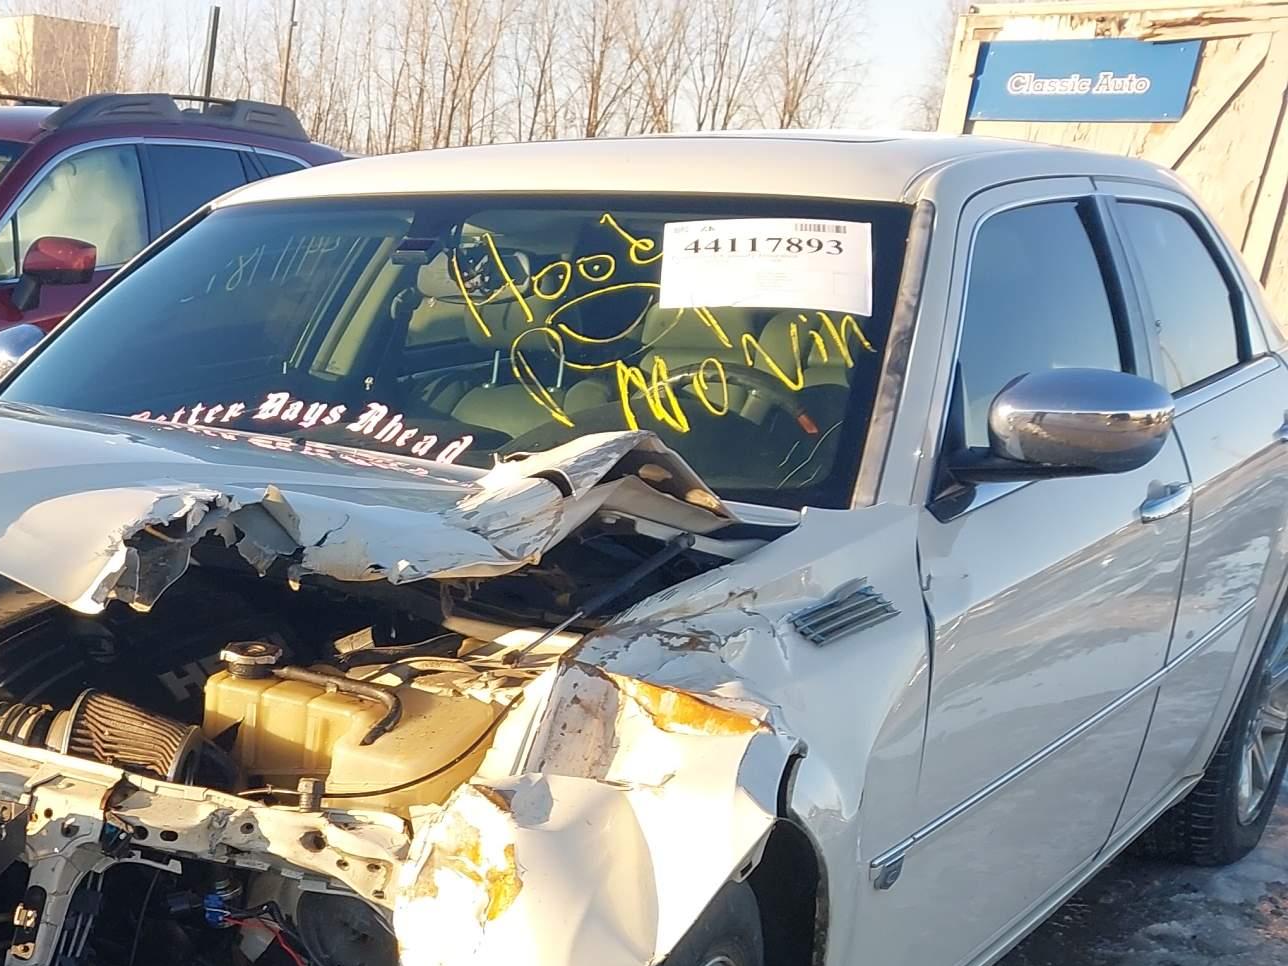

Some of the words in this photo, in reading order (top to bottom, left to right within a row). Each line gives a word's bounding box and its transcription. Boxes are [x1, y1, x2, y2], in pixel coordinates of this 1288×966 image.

[1008, 73, 1091, 94] Classic
[1092, 72, 1150, 94] Auto
[684, 237, 845, 256] 44117893
[253, 392, 347, 428] Days
[345, 402, 474, 464] Ahead
